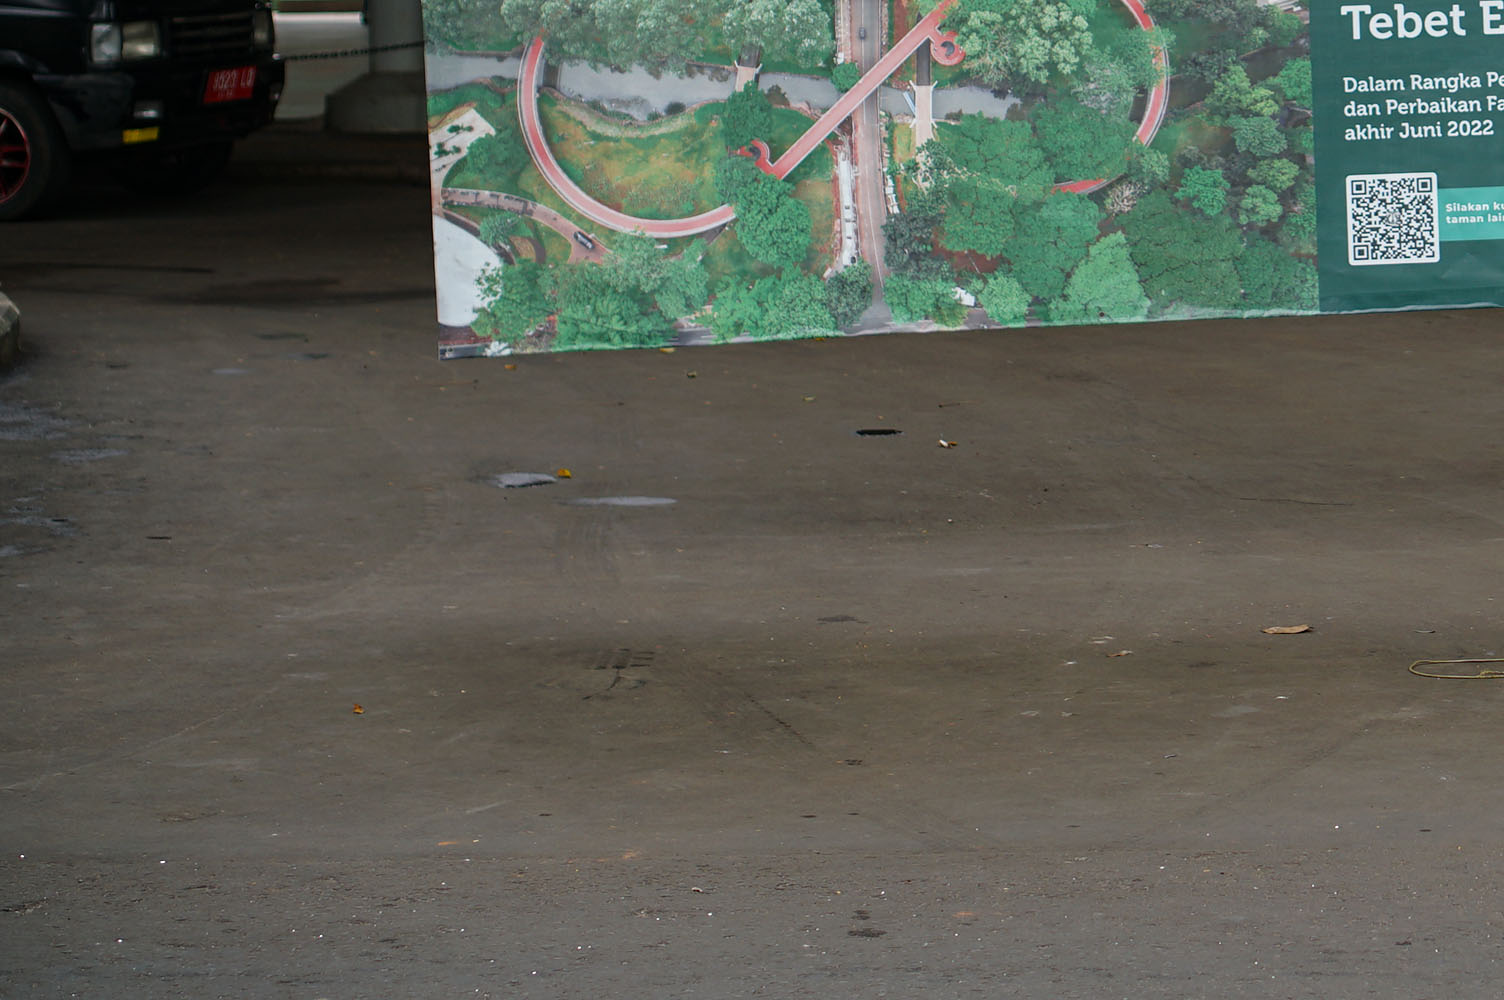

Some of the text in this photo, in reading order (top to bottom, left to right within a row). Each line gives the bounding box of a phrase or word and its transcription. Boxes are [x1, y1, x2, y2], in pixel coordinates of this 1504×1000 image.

[1340, 2, 1467, 40] Tebet
[1343, 75, 1405, 93] Dalam
[1410, 72, 1482, 95] Rangka
[1343, 98, 1381, 117] dan
[1386, 95, 1482, 115] Perbaikan
[1344, 119, 1494, 141] akhir Juni 2022
[1445, 203, 1490, 212] Silakan
[1446, 215, 1484, 224] taman
